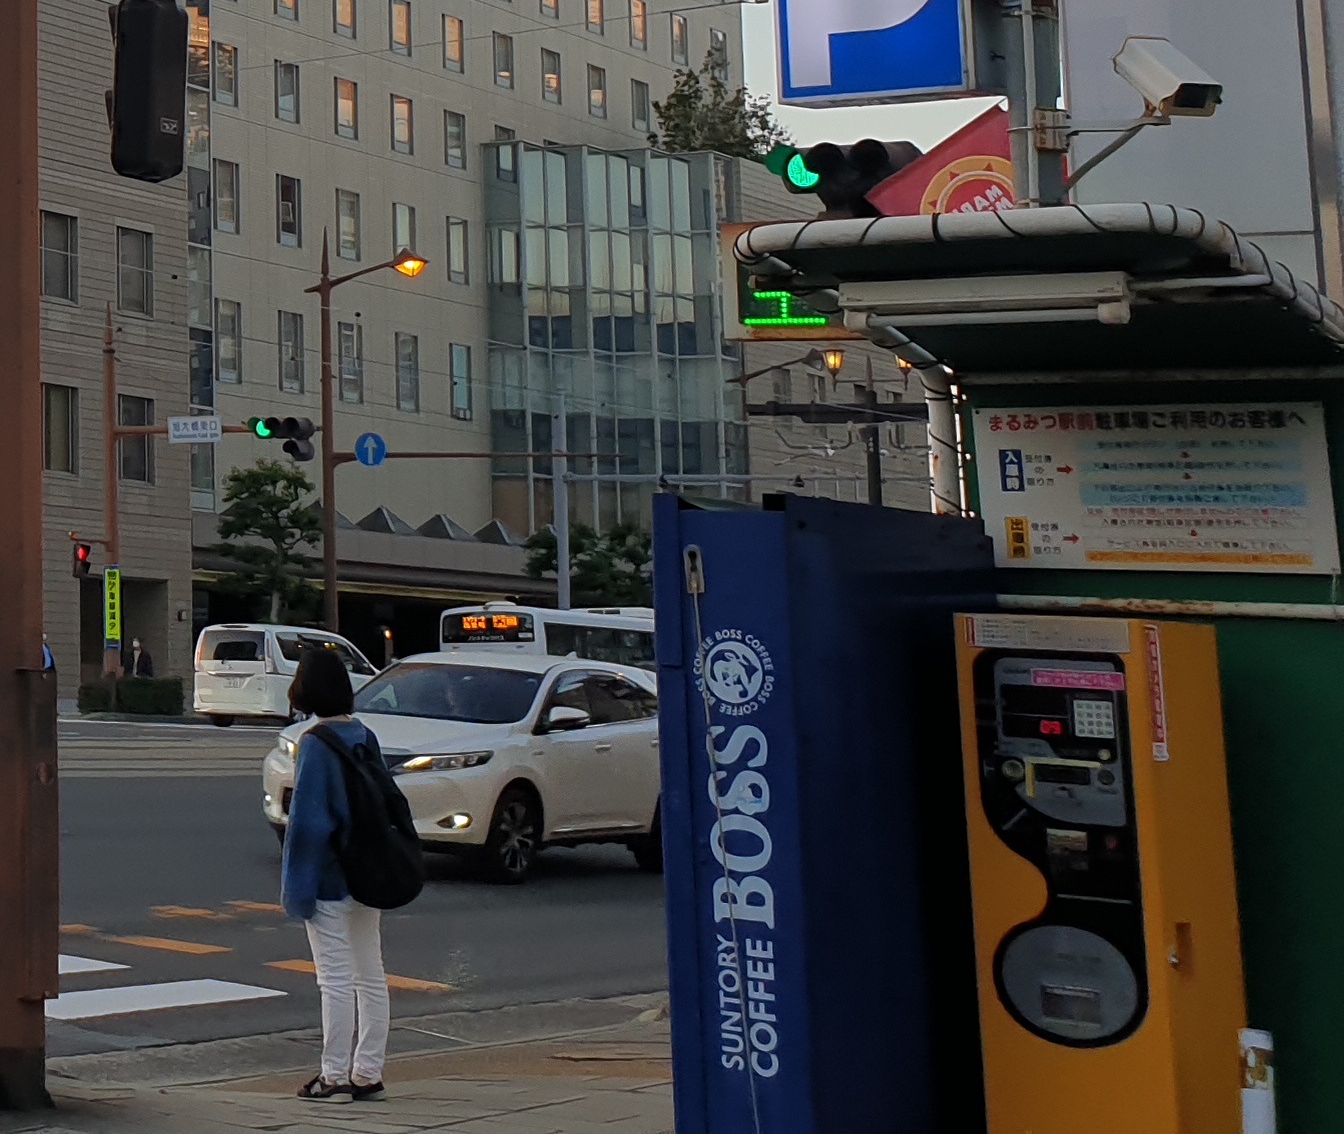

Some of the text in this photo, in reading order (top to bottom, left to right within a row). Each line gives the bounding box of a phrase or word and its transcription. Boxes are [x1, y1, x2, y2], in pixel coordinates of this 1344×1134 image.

[714, 628, 742, 641] BOSS
[745, 634, 774, 671] COFFEE
[757, 675, 775, 704] BOSS
[718, 701, 758, 716] COFFEE
[706, 724, 775, 931] BOSS
[717, 933, 744, 1071] SUNTORY
[746, 937, 778, 1079] COFFEE
